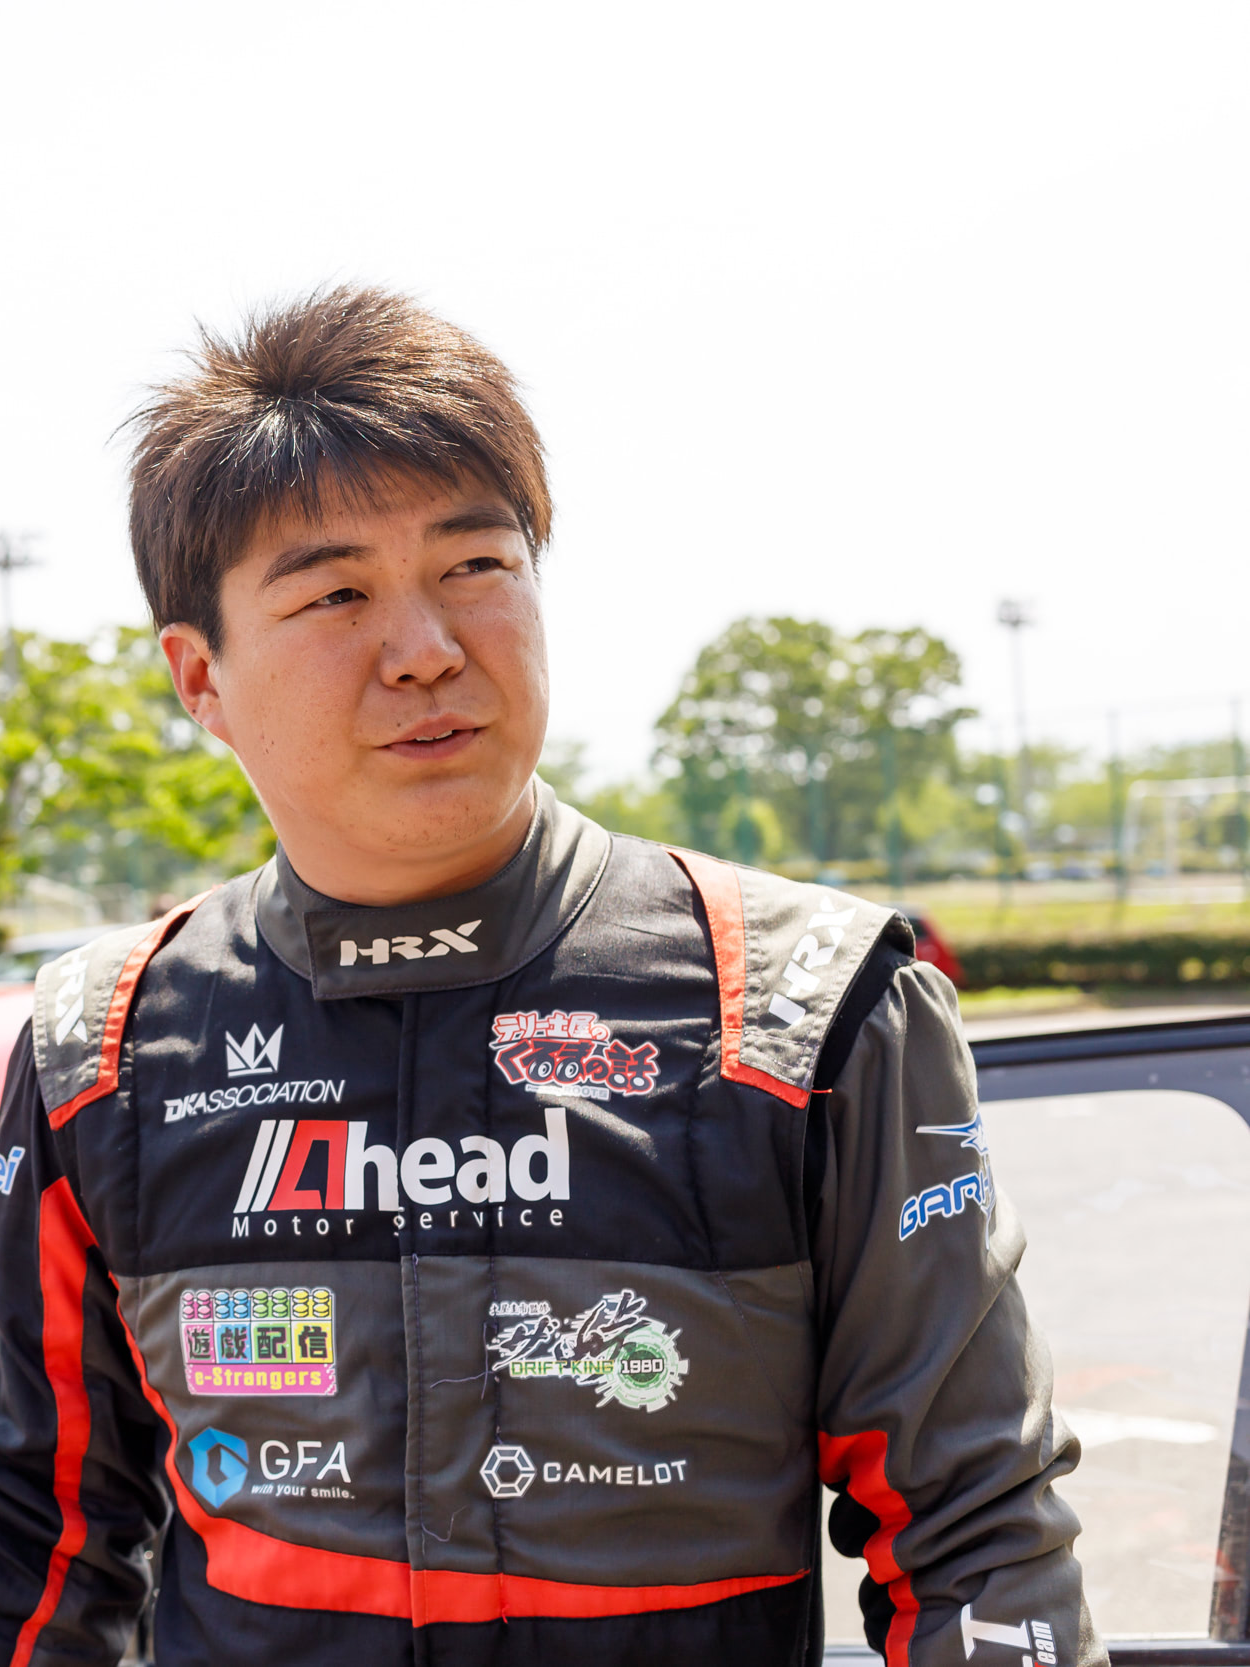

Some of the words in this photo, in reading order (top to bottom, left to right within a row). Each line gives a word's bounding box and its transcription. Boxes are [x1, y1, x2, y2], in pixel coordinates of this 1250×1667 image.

[340, 919, 483, 966] HRX
[768, 894, 857, 1026] HRX
[232, 1215, 355, 1238] Motor
[393, 1205, 564, 1237] Service
[194, 1366, 322, 1391] e-Strangers
[510, 1359, 568, 1375] DRIFT
[570, 1359, 615, 1375] KING
[620, 1358, 665, 1374] 1980
[259, 1439, 353, 1484] GFA
[543, 1460, 688, 1486] CAMELOT
[250, 1483, 274, 1495] with
[275, 1484, 307, 1497] your
[310, 1486, 356, 1499] smile.
